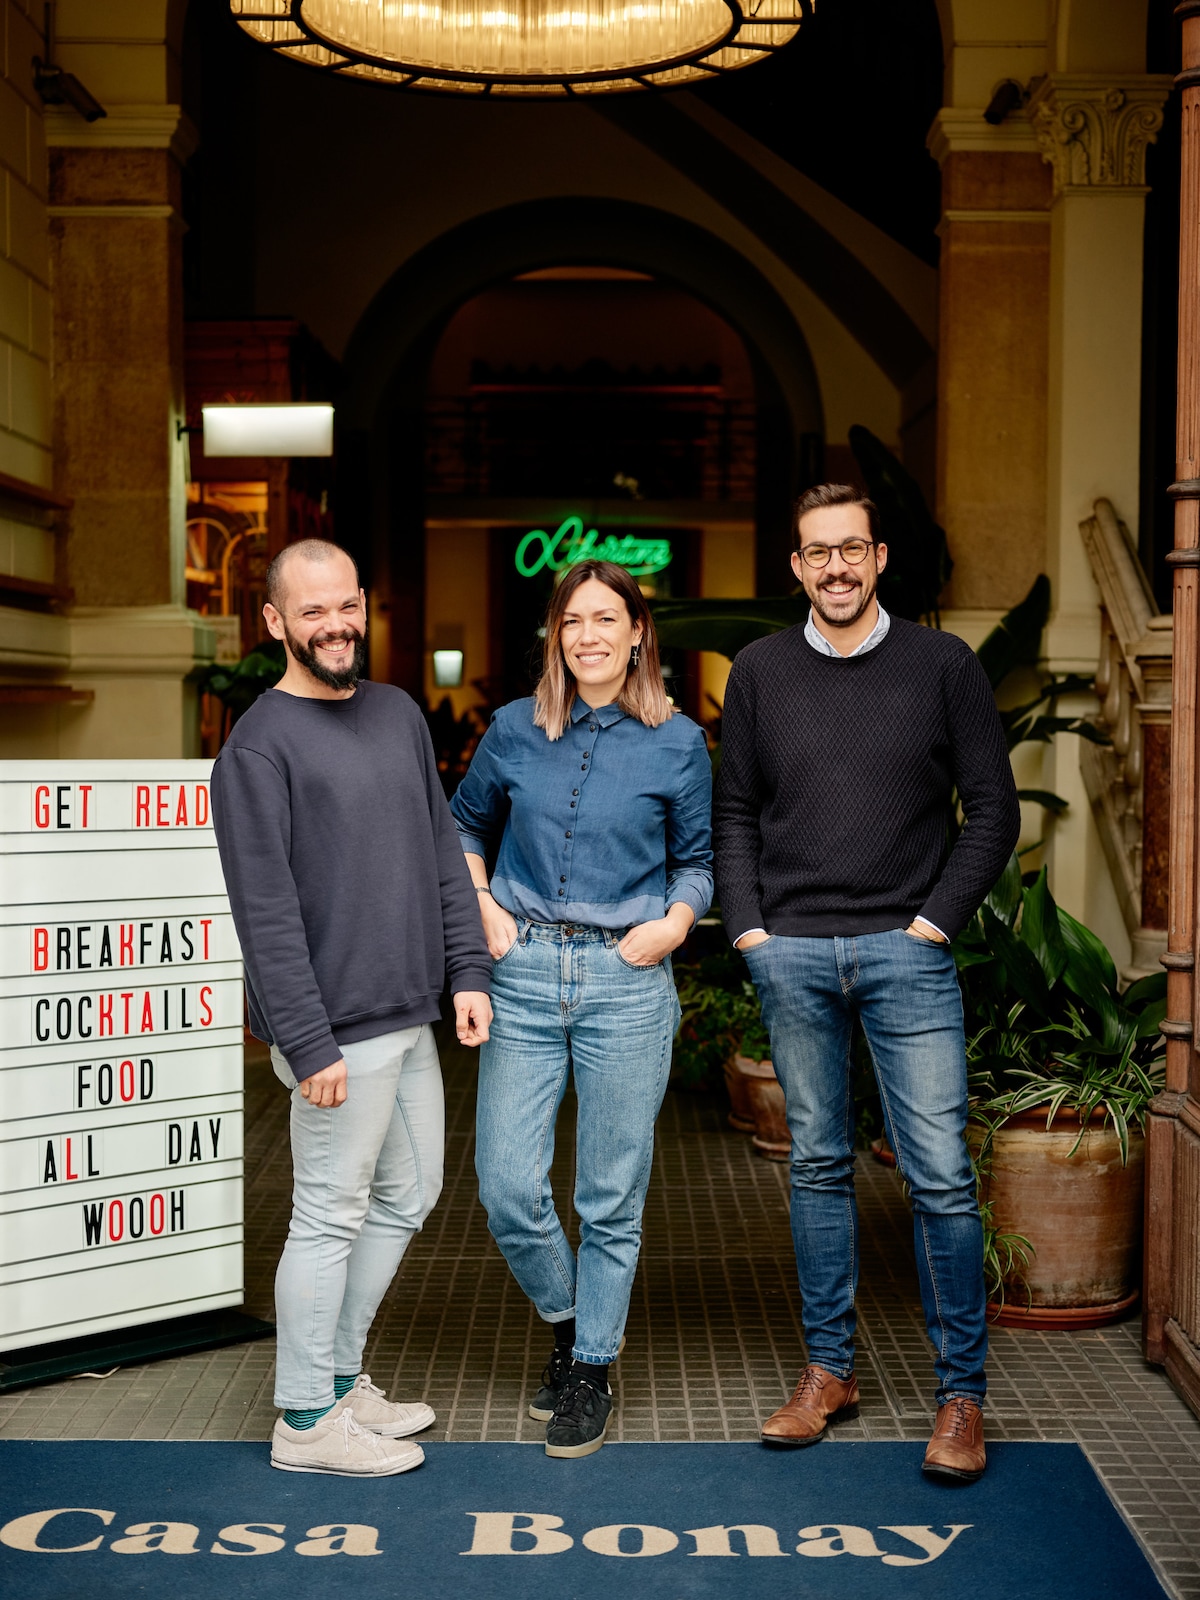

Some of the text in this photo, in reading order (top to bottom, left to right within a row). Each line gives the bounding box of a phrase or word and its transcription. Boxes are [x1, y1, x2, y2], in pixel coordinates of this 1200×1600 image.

[35, 784, 209, 829] GET READ
[33, 919, 213, 972] BREAKFAST
[35, 985, 214, 1042] COCKTAILS
[77, 1058, 154, 1108] FOOD
[43, 1117, 222, 1183] ALL DAY
[83, 1189, 185, 1247] WOOOH
[0, 1507, 976, 1568] Casa Bonay
